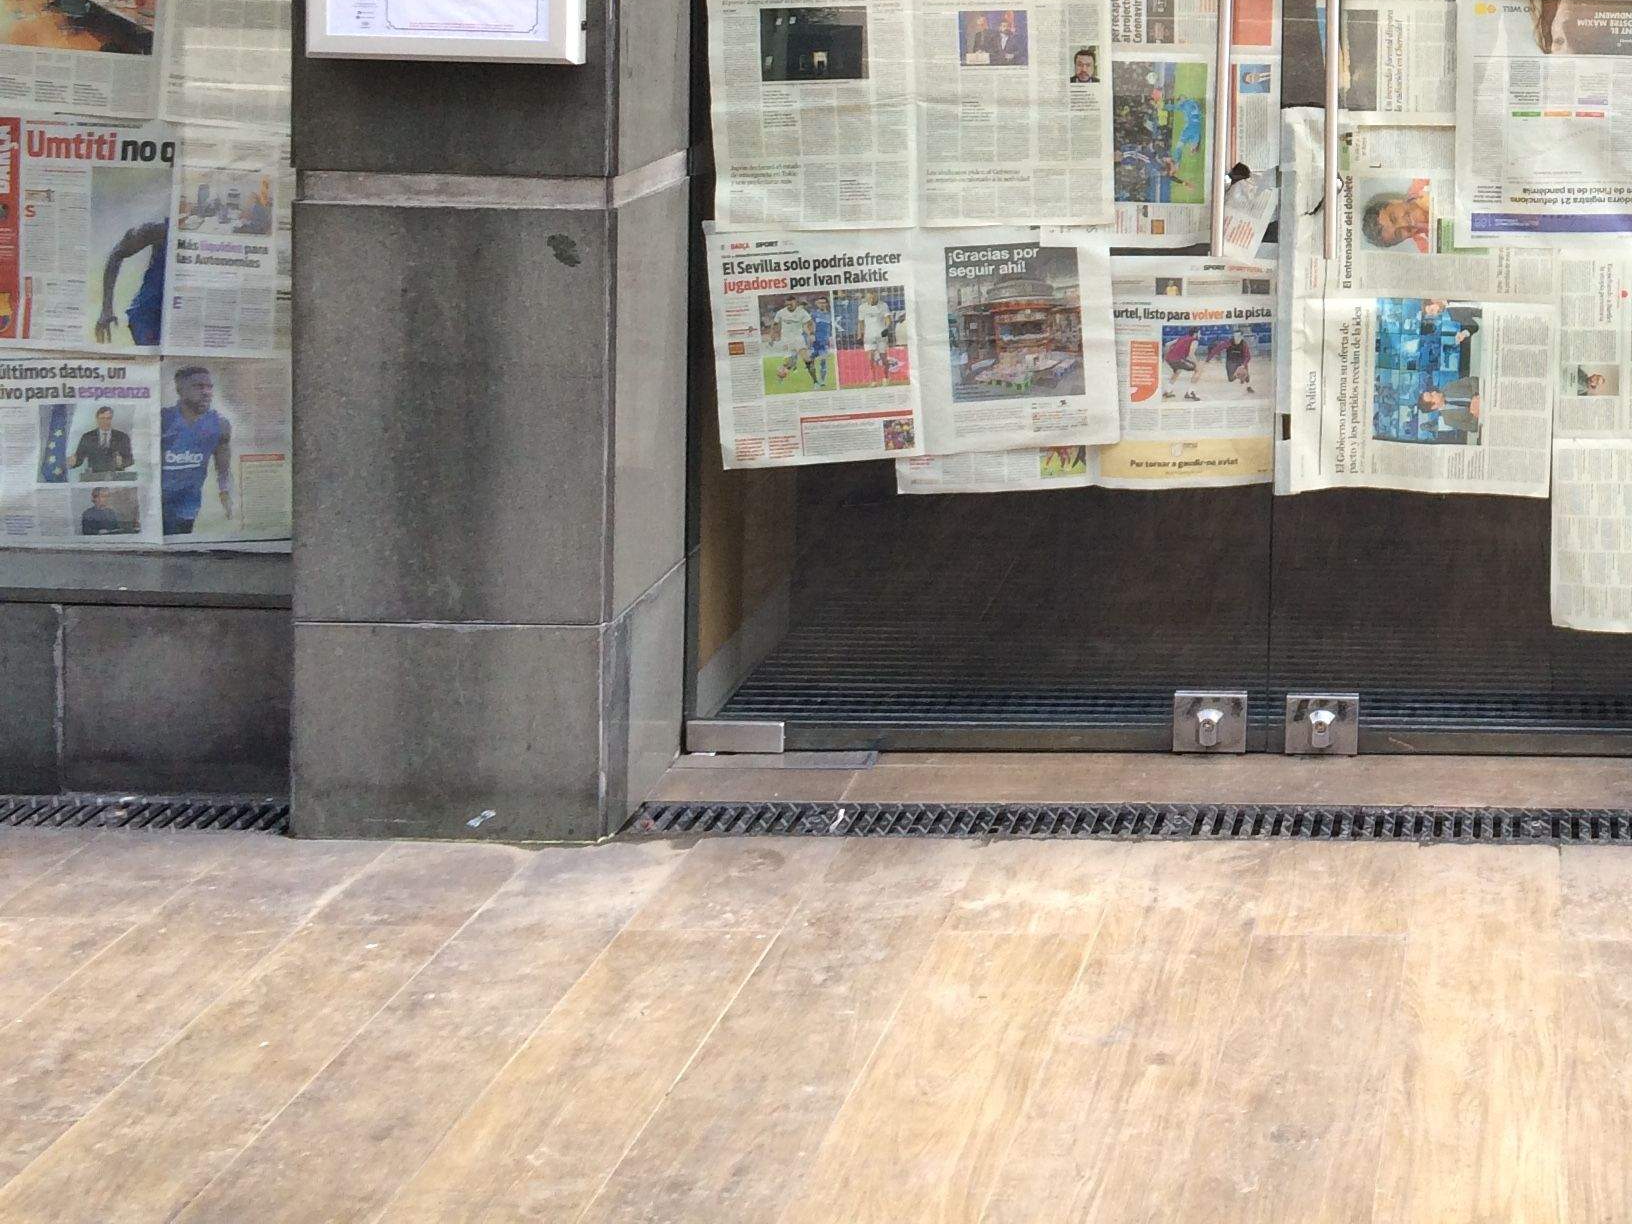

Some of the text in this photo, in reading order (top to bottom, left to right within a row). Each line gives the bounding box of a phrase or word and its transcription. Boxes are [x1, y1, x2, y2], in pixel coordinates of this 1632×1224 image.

[26, 129, 156, 162] Umtiti no
[1510, 196, 1558, 205] defuncions
[1561, 197, 1571, 205] 21
[1573, 195, 1606, 205] registra
[1342, 176, 1353, 289] El entrenador del doblete
[722, 252, 902, 276] El Sevilla solo podría ofrecer
[948, 247, 1040, 266] ¡Gracias por
[949, 260, 1027, 279] seguir ahí!
[723, 277, 788, 294] jugadores
[790, 275, 812, 291] por
[844, 268, 888, 284] Rakitic
[1113, 307, 1271, 323] urtel, listo para volver a la pista
[0, 363, 127, 383] últimos datos, un
[1306, 371, 1317, 411] Política
[165, 451, 203, 464] beko
